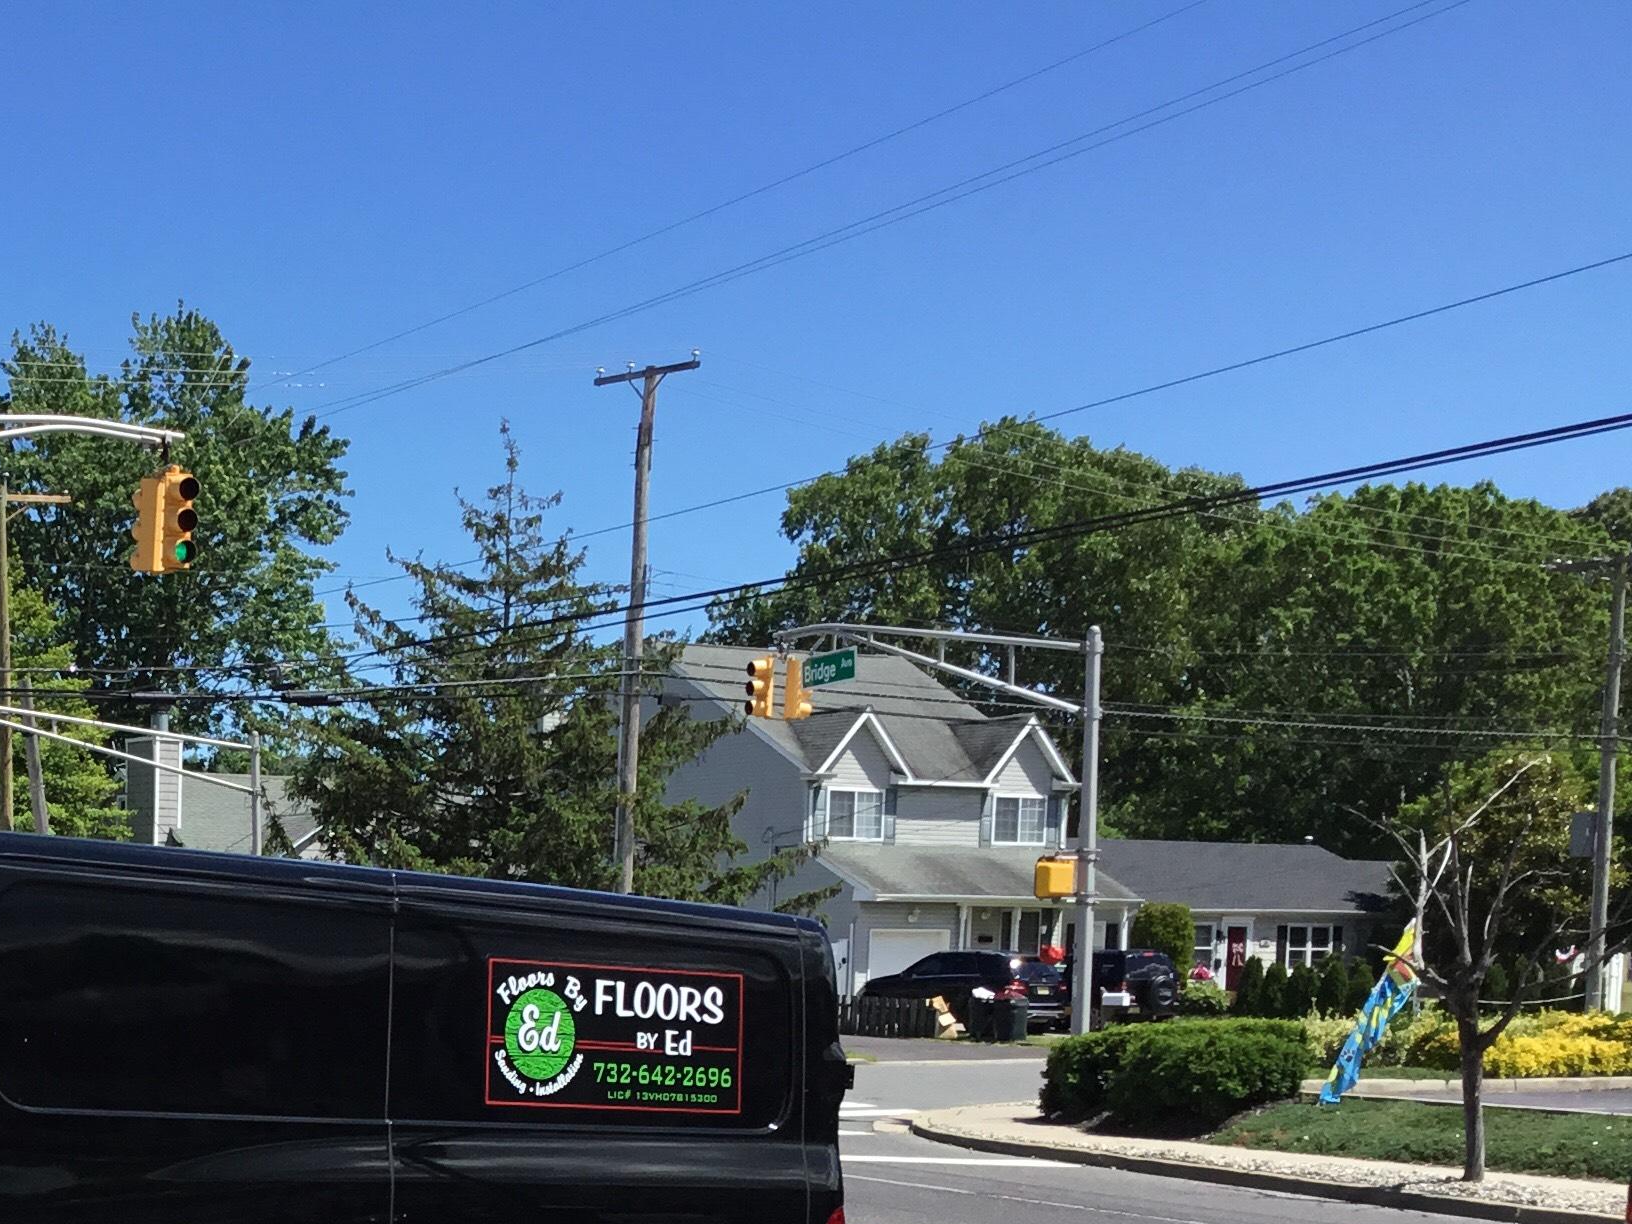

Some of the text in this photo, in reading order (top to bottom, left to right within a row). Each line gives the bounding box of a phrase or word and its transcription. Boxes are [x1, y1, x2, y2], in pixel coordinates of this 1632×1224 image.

[804, 662, 836, 682] Bridge
[496, 971, 588, 1012] Floors By
[594, 979, 724, 1024] FLOORS
[518, 1004, 561, 1052] Ed
[636, 1030, 692, 1056] BY Ed
[494, 1049, 584, 1096] Sanding Installation
